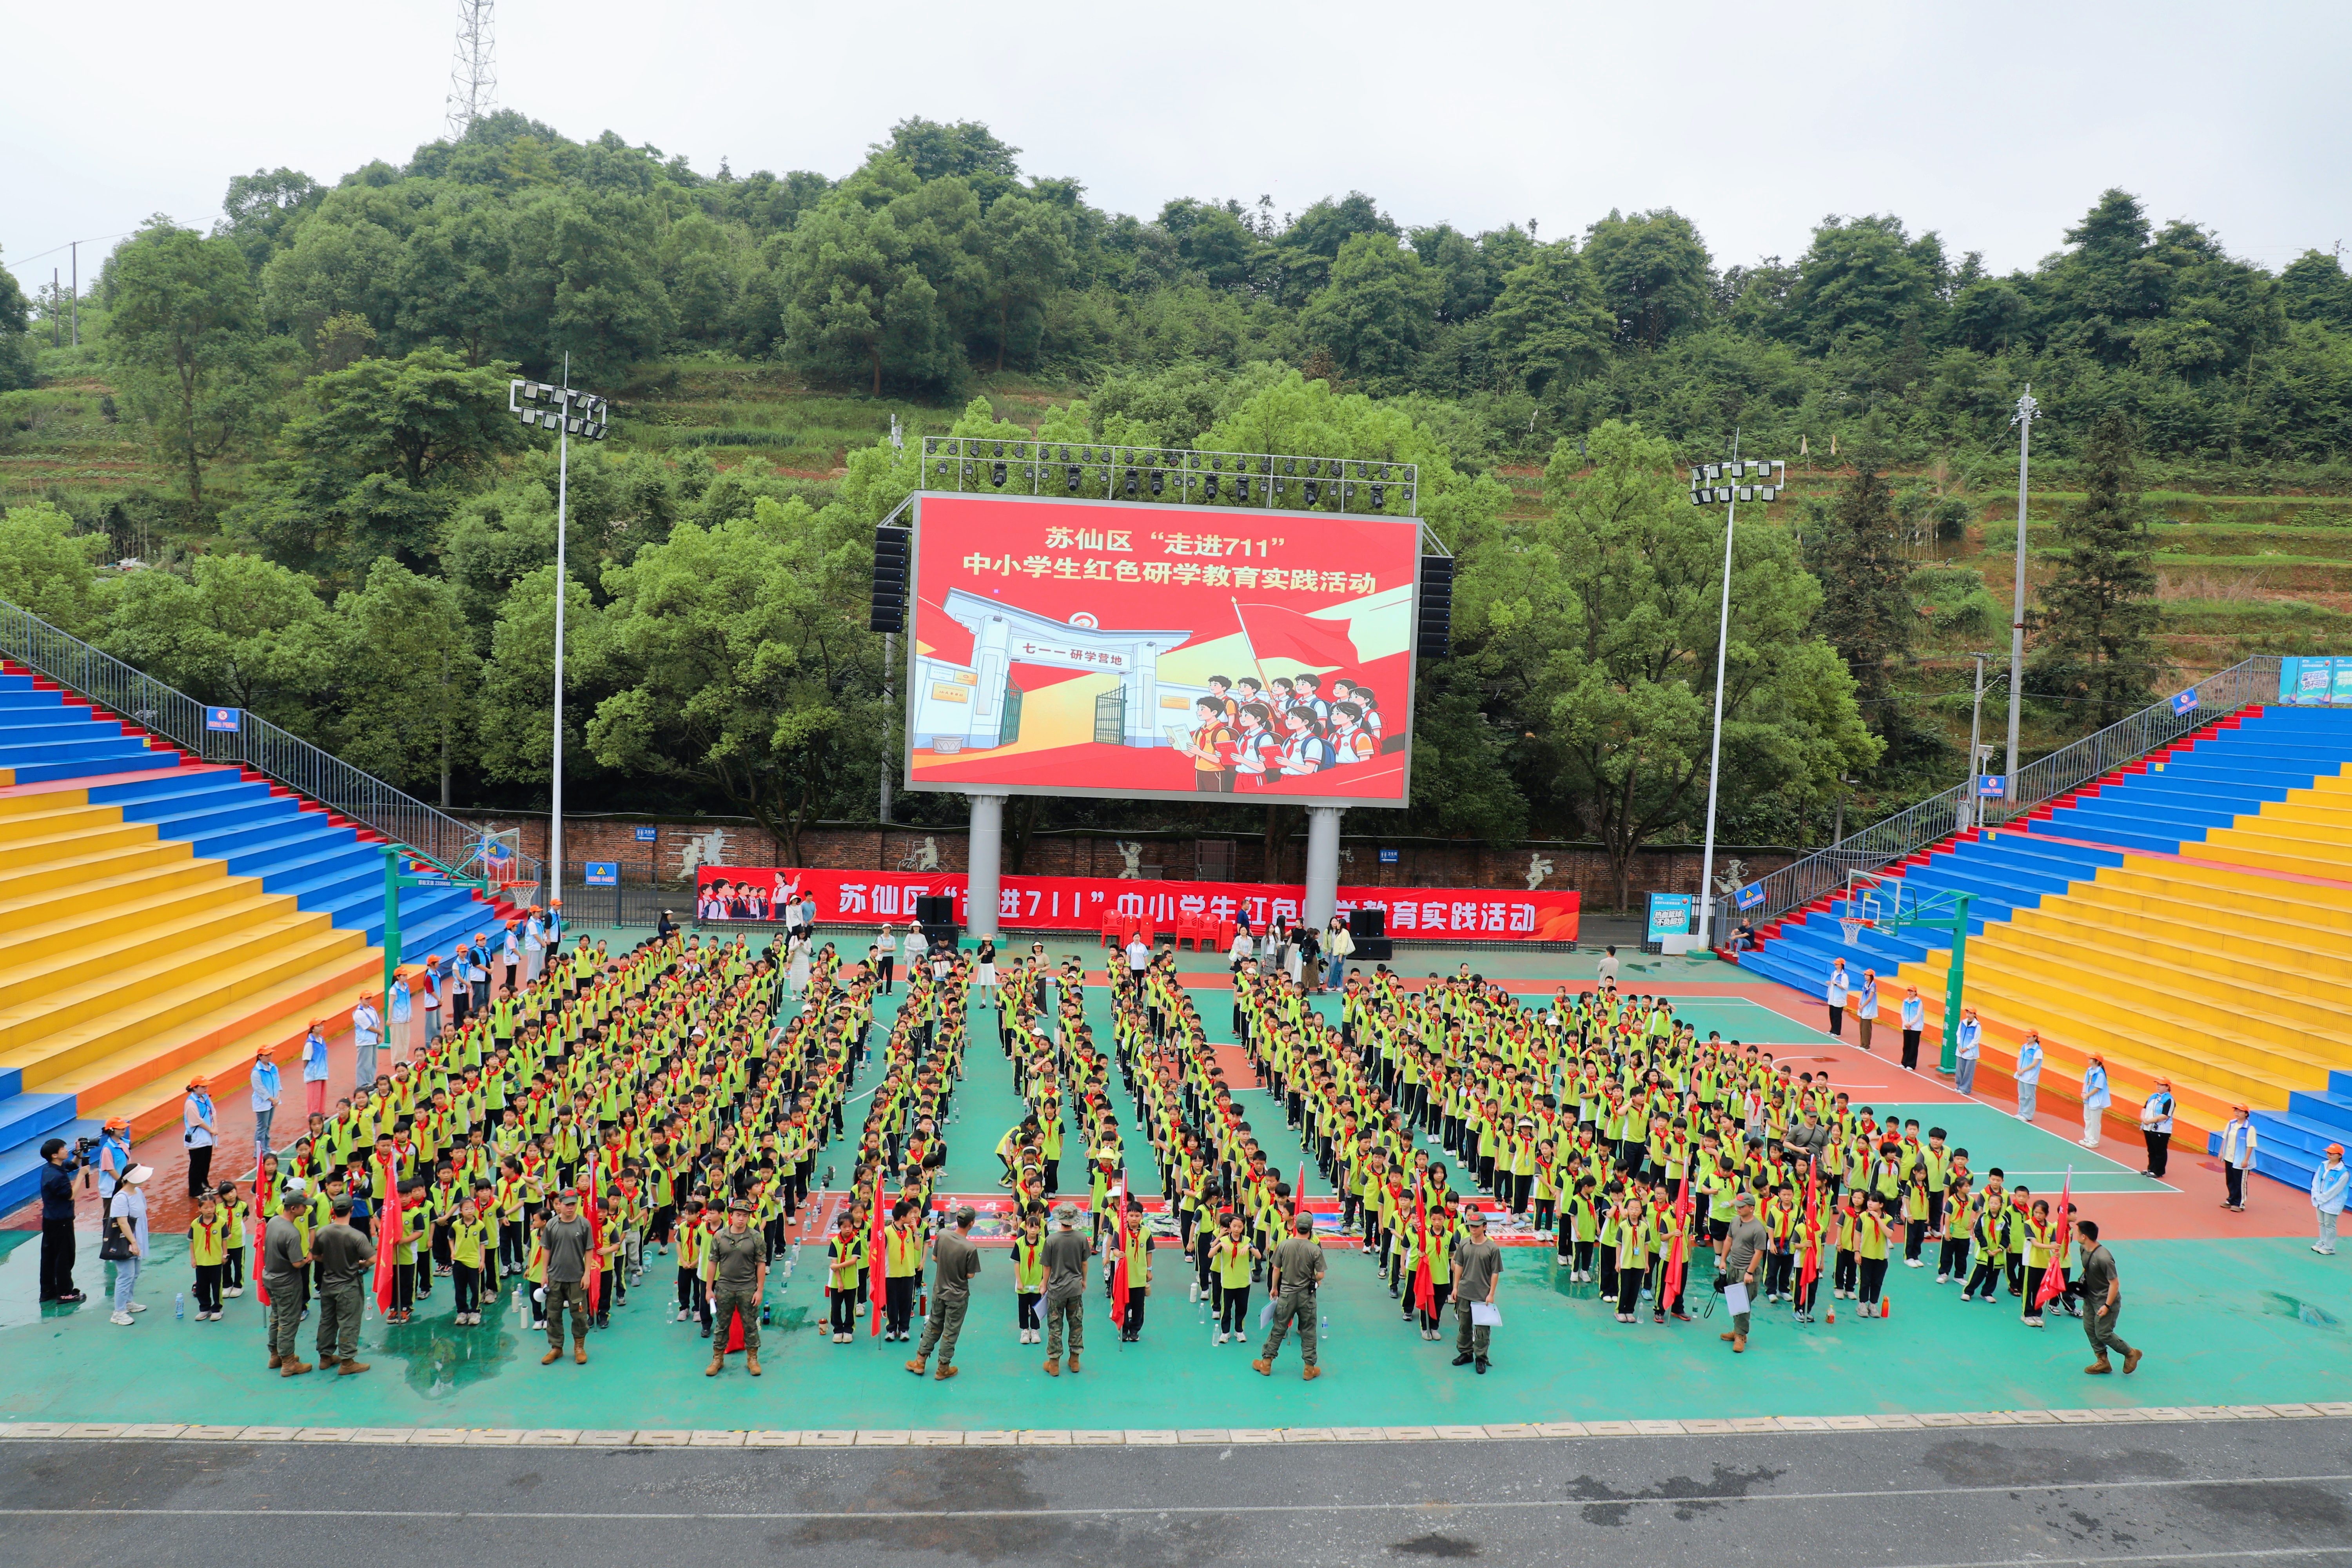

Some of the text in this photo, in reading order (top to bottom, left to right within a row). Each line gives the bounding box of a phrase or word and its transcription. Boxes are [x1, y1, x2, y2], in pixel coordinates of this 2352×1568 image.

[963, 552, 1376, 594] 中小学生红色研学教育实践活动
[1023, 643, 1122, 666] 七一一研学营地
[839, 884, 1535, 932] 苏仙区“进711”中小学生红色学育实践活动
[1655, 917, 1684, 926] 不负韶华
